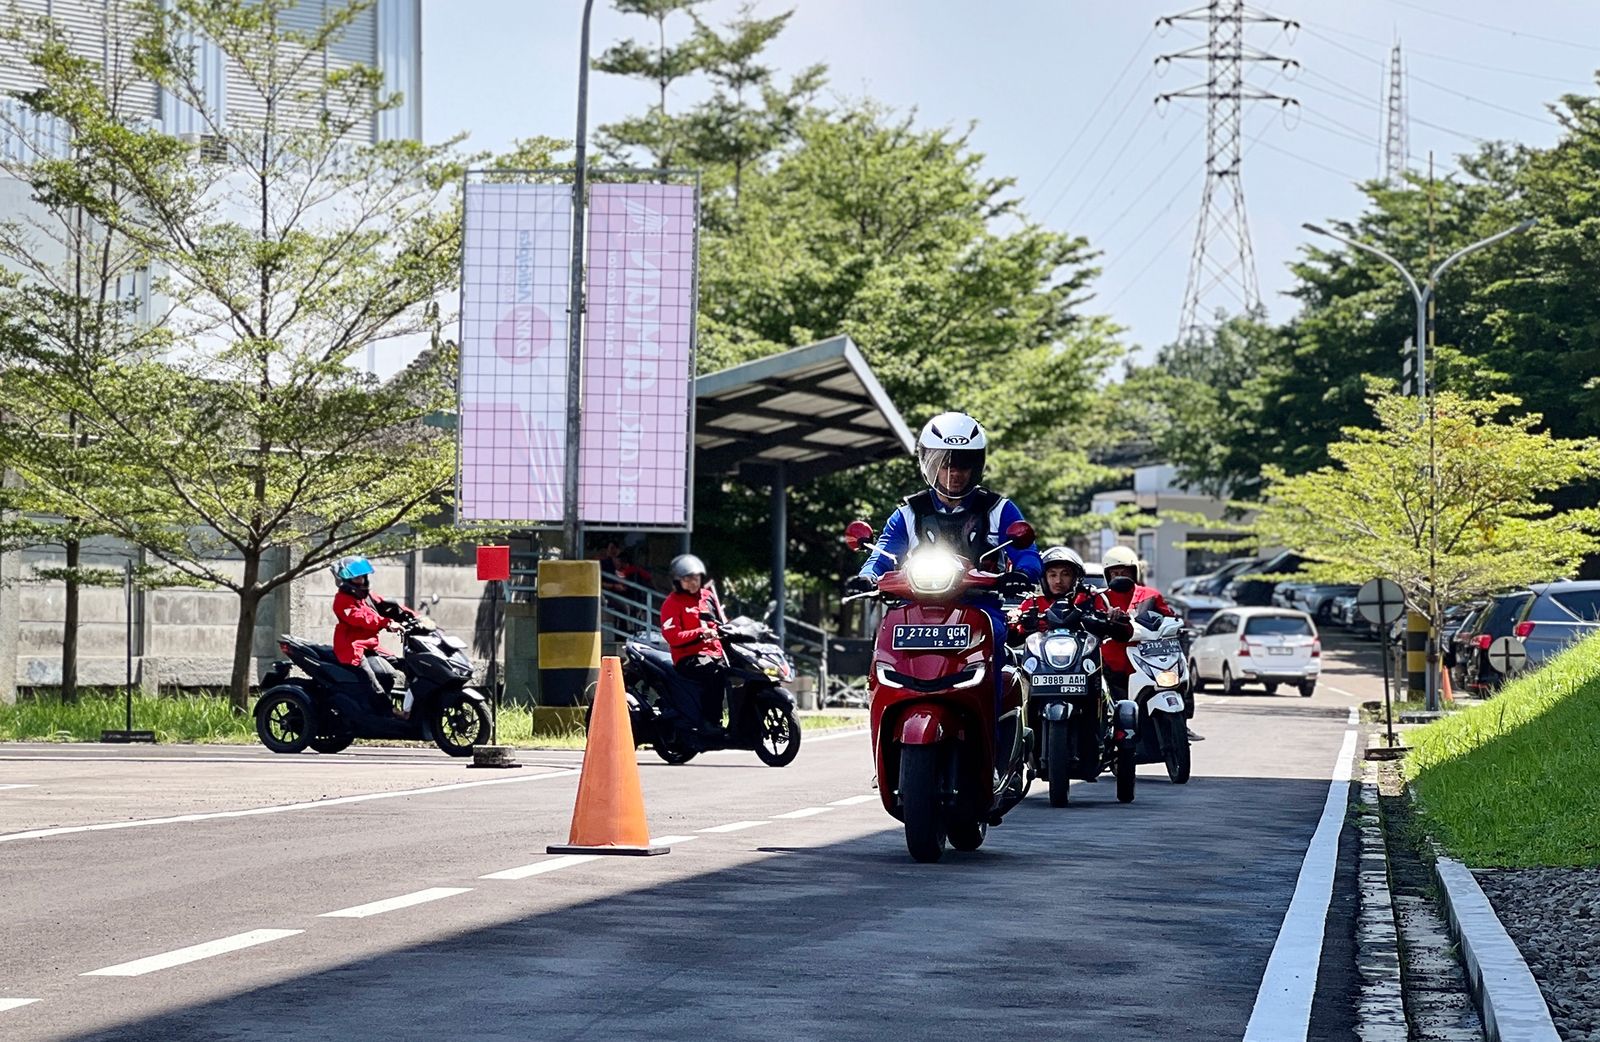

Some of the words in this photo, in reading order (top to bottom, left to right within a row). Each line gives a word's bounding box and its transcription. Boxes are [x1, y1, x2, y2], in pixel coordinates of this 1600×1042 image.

[897, 628, 904, 637] D
[908, 628, 939, 638] 2728
[1033, 676, 1039, 685] D
[1042, 676, 1064, 685] 3888
